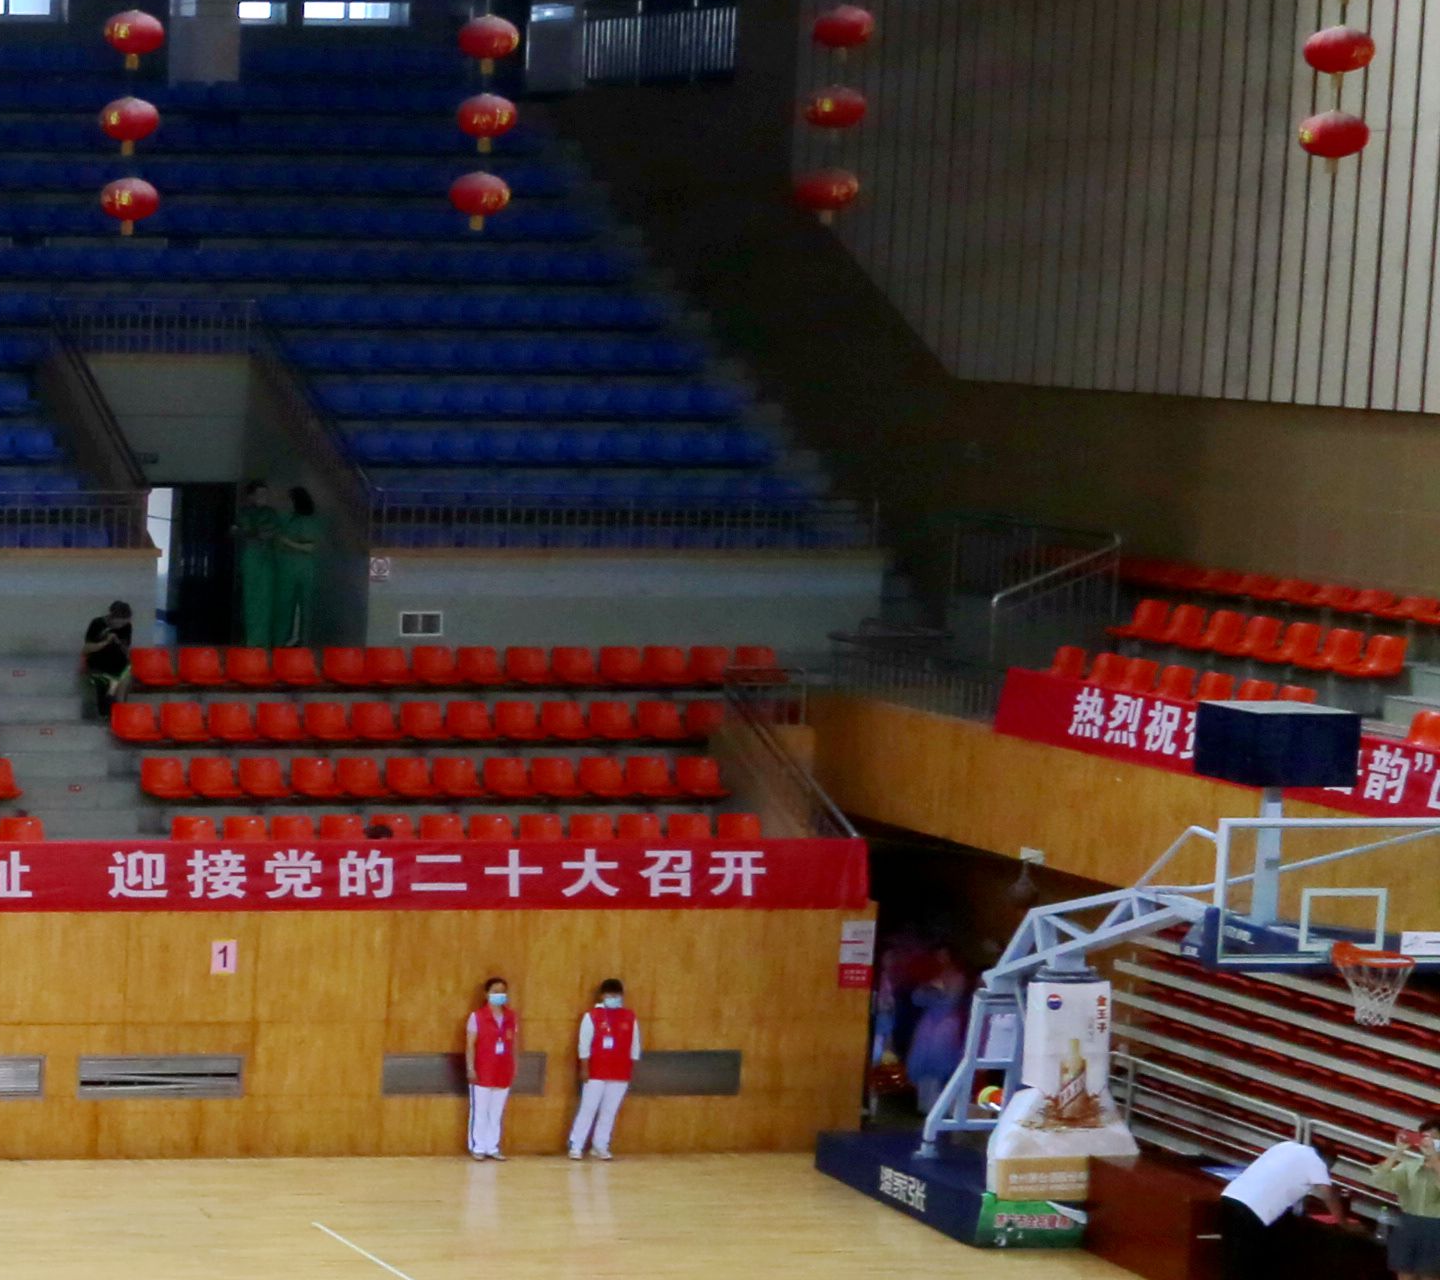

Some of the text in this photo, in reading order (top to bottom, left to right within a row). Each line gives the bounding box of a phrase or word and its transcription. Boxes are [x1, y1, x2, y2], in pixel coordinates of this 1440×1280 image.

[108, 849, 767, 900] 迎接党的二十大召开
[217, 945, 230, 969] 1
